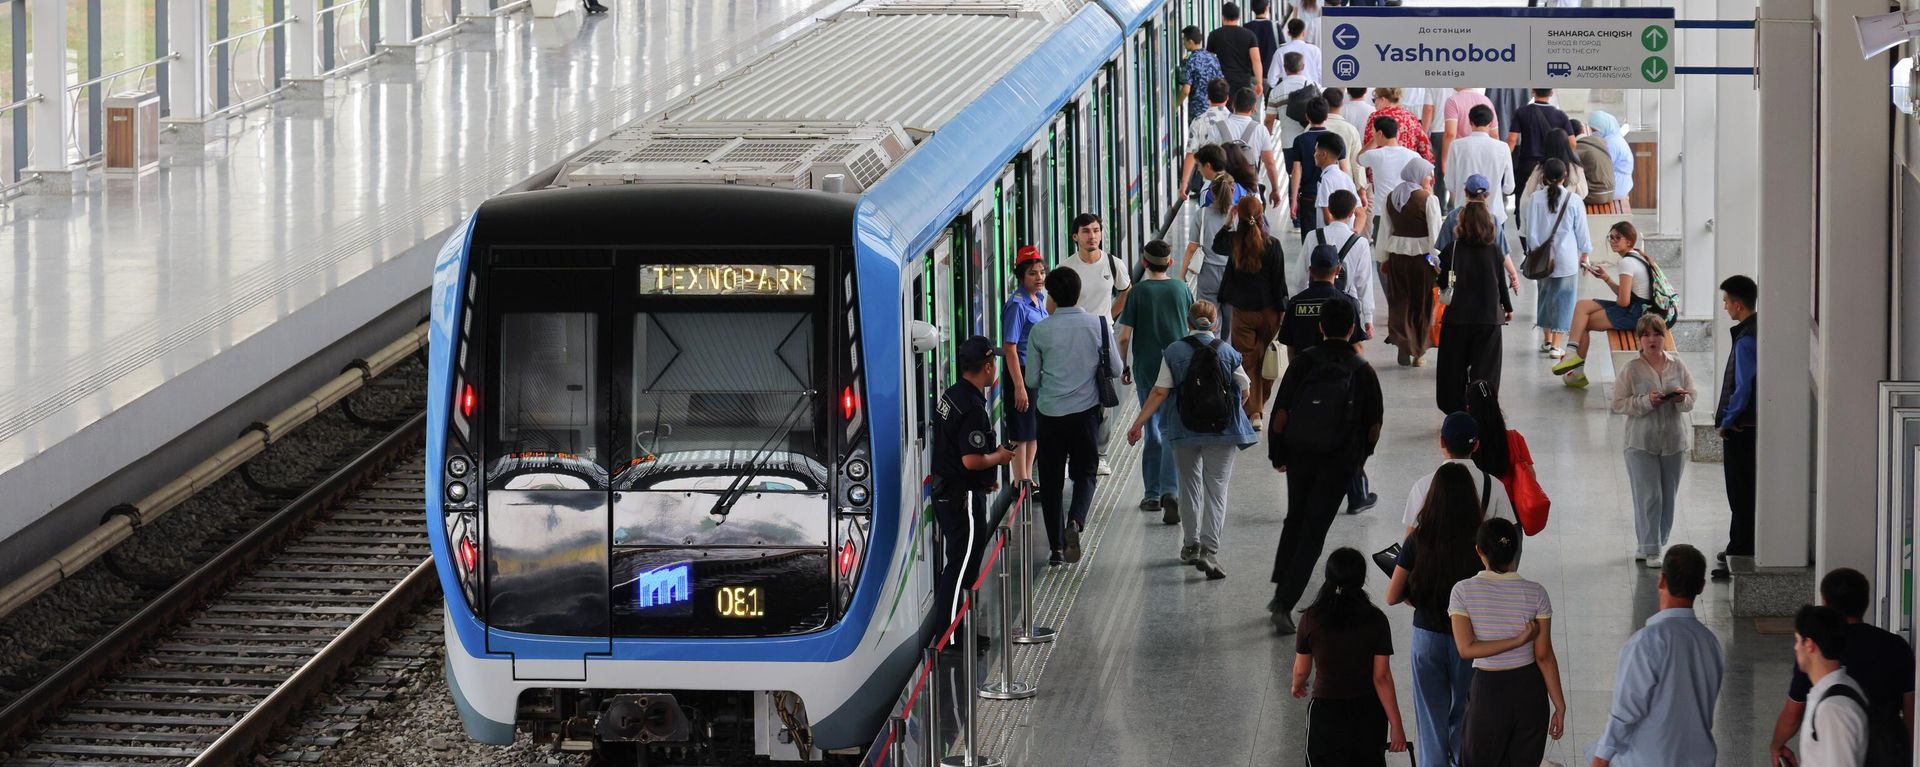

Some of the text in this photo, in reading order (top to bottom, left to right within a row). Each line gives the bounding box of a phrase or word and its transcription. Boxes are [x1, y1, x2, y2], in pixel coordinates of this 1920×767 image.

[1597, 30, 1632, 38] CHIQISH
[1374, 43, 1516, 62] Yashnobod
[1424, 69, 1465, 77] Bekatiga
[653, 267, 807, 291] TEXNOPARK
